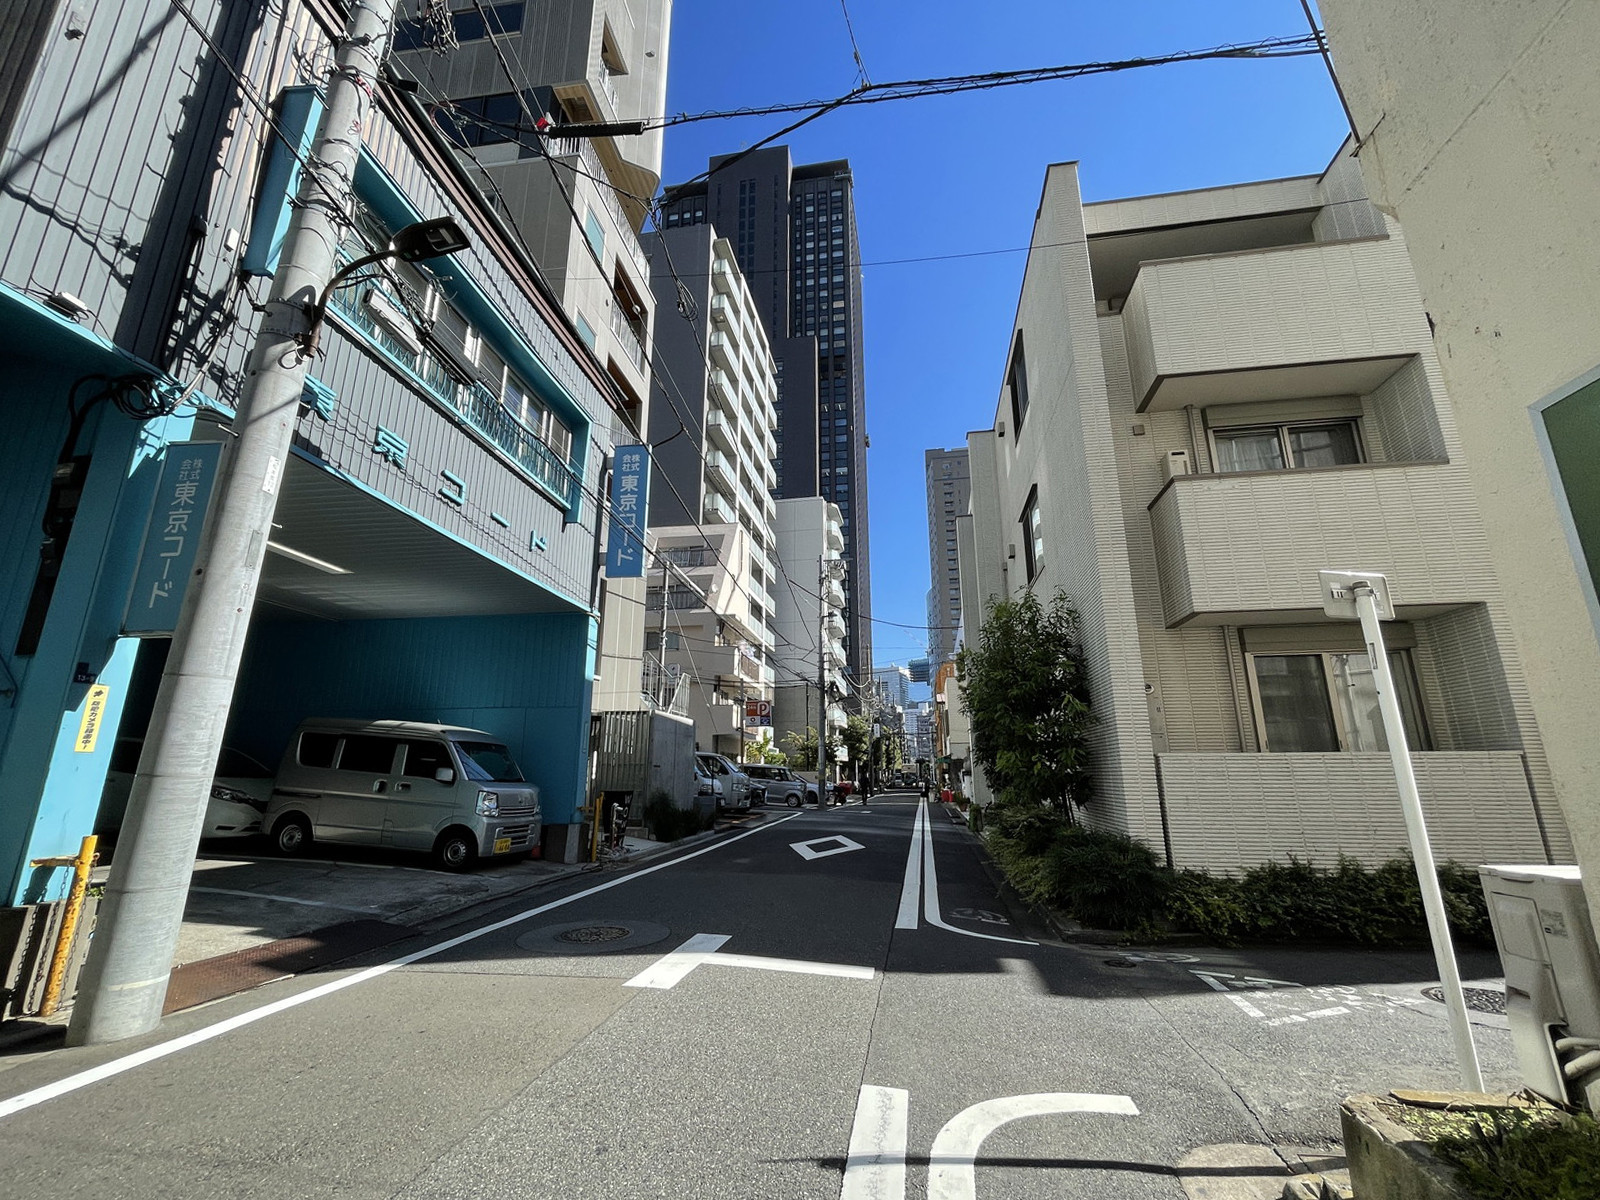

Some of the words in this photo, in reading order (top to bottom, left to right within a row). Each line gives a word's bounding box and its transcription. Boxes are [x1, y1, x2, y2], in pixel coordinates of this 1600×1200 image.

[299, 373, 547, 552] 東京コード
[148, 481, 199, 609] 東京コード
[617, 474, 640, 567] 東京コード
[757, 701, 770, 716] P
